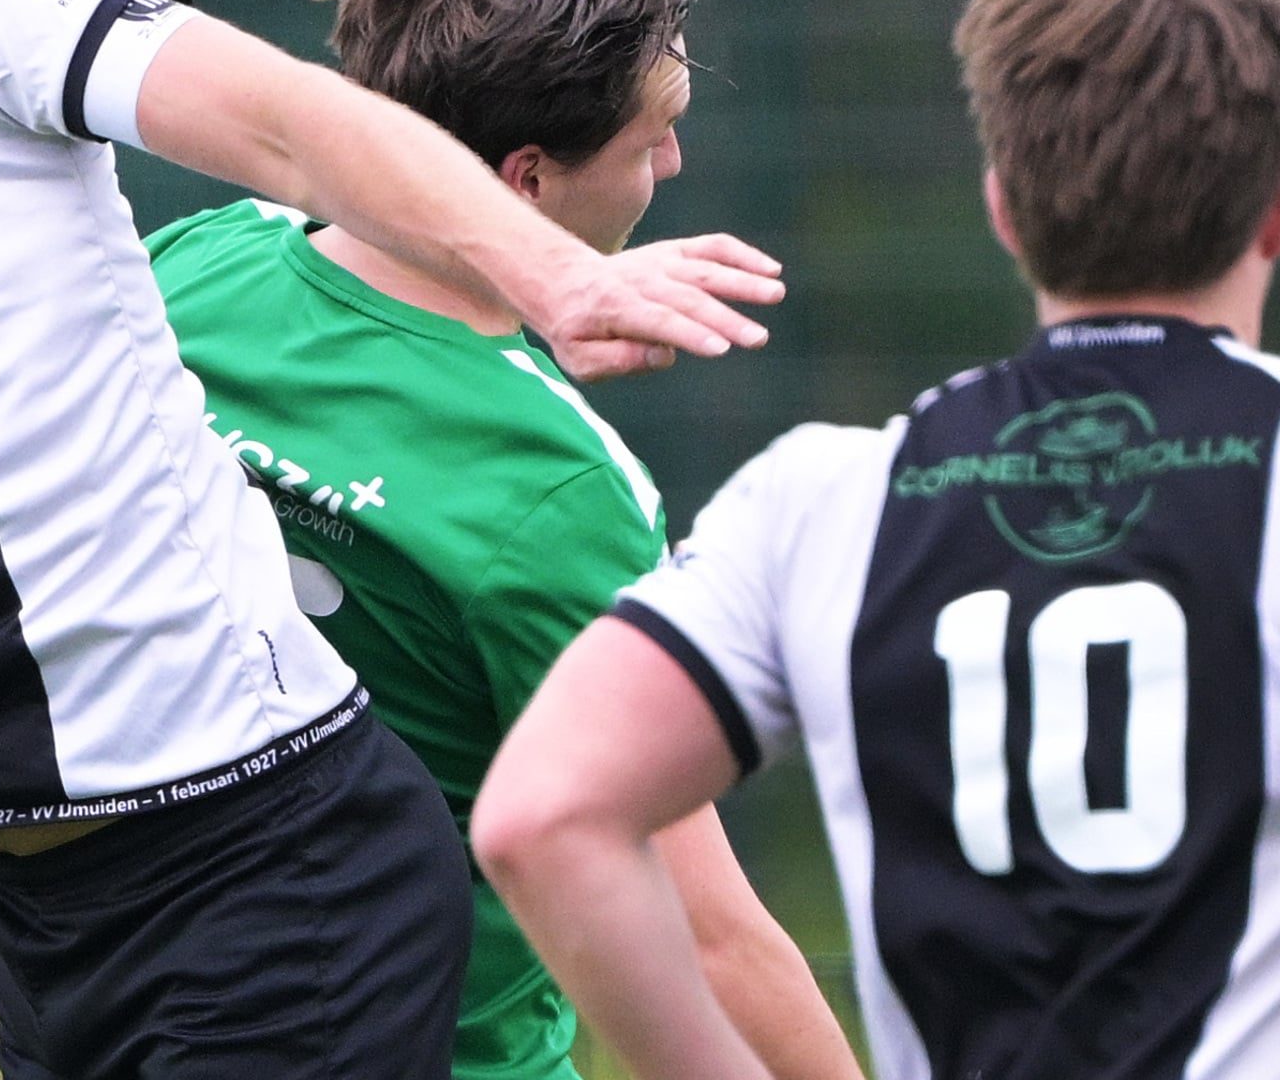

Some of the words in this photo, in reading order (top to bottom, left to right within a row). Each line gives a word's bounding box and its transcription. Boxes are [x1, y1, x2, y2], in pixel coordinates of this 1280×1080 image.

[275, 494, 354, 547] Growth
[934, 580, 1188, 876] 10
[32, 806, 54, 820] VV
[58, 799, 138, 818] IJmuiden
[157, 790, 166, 804] 1
[171, 768, 239, 801] februari
[242, 749, 277, 777] 1927
[289, 733, 308, 753] VV
